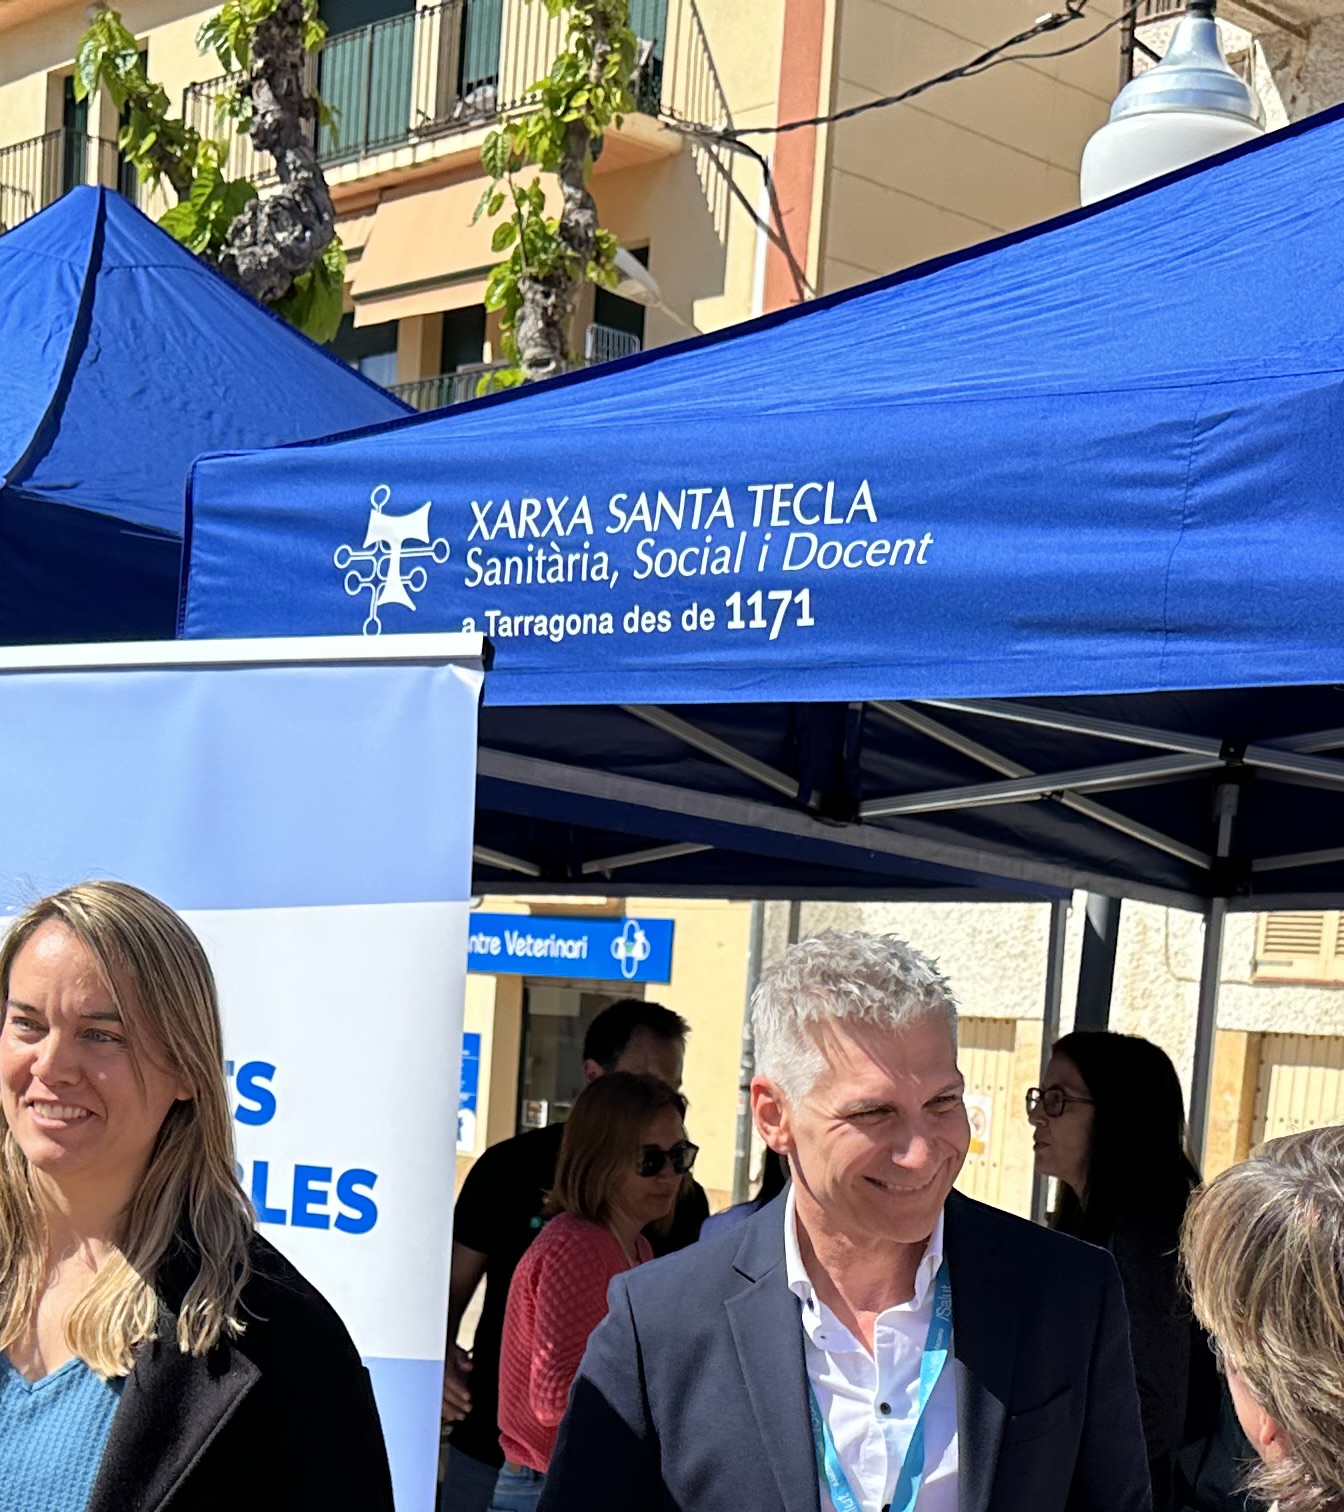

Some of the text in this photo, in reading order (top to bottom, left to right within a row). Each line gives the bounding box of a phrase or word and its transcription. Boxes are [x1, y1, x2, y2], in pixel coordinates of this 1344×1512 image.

[467, 480, 878, 541] XARXA SANTA TECLA
[464, 531, 934, 589] Sanitària, Social i Docent
[461, 588, 815, 643] a Tarragona des de 1171
[504, 929, 588, 959] Veterinari
